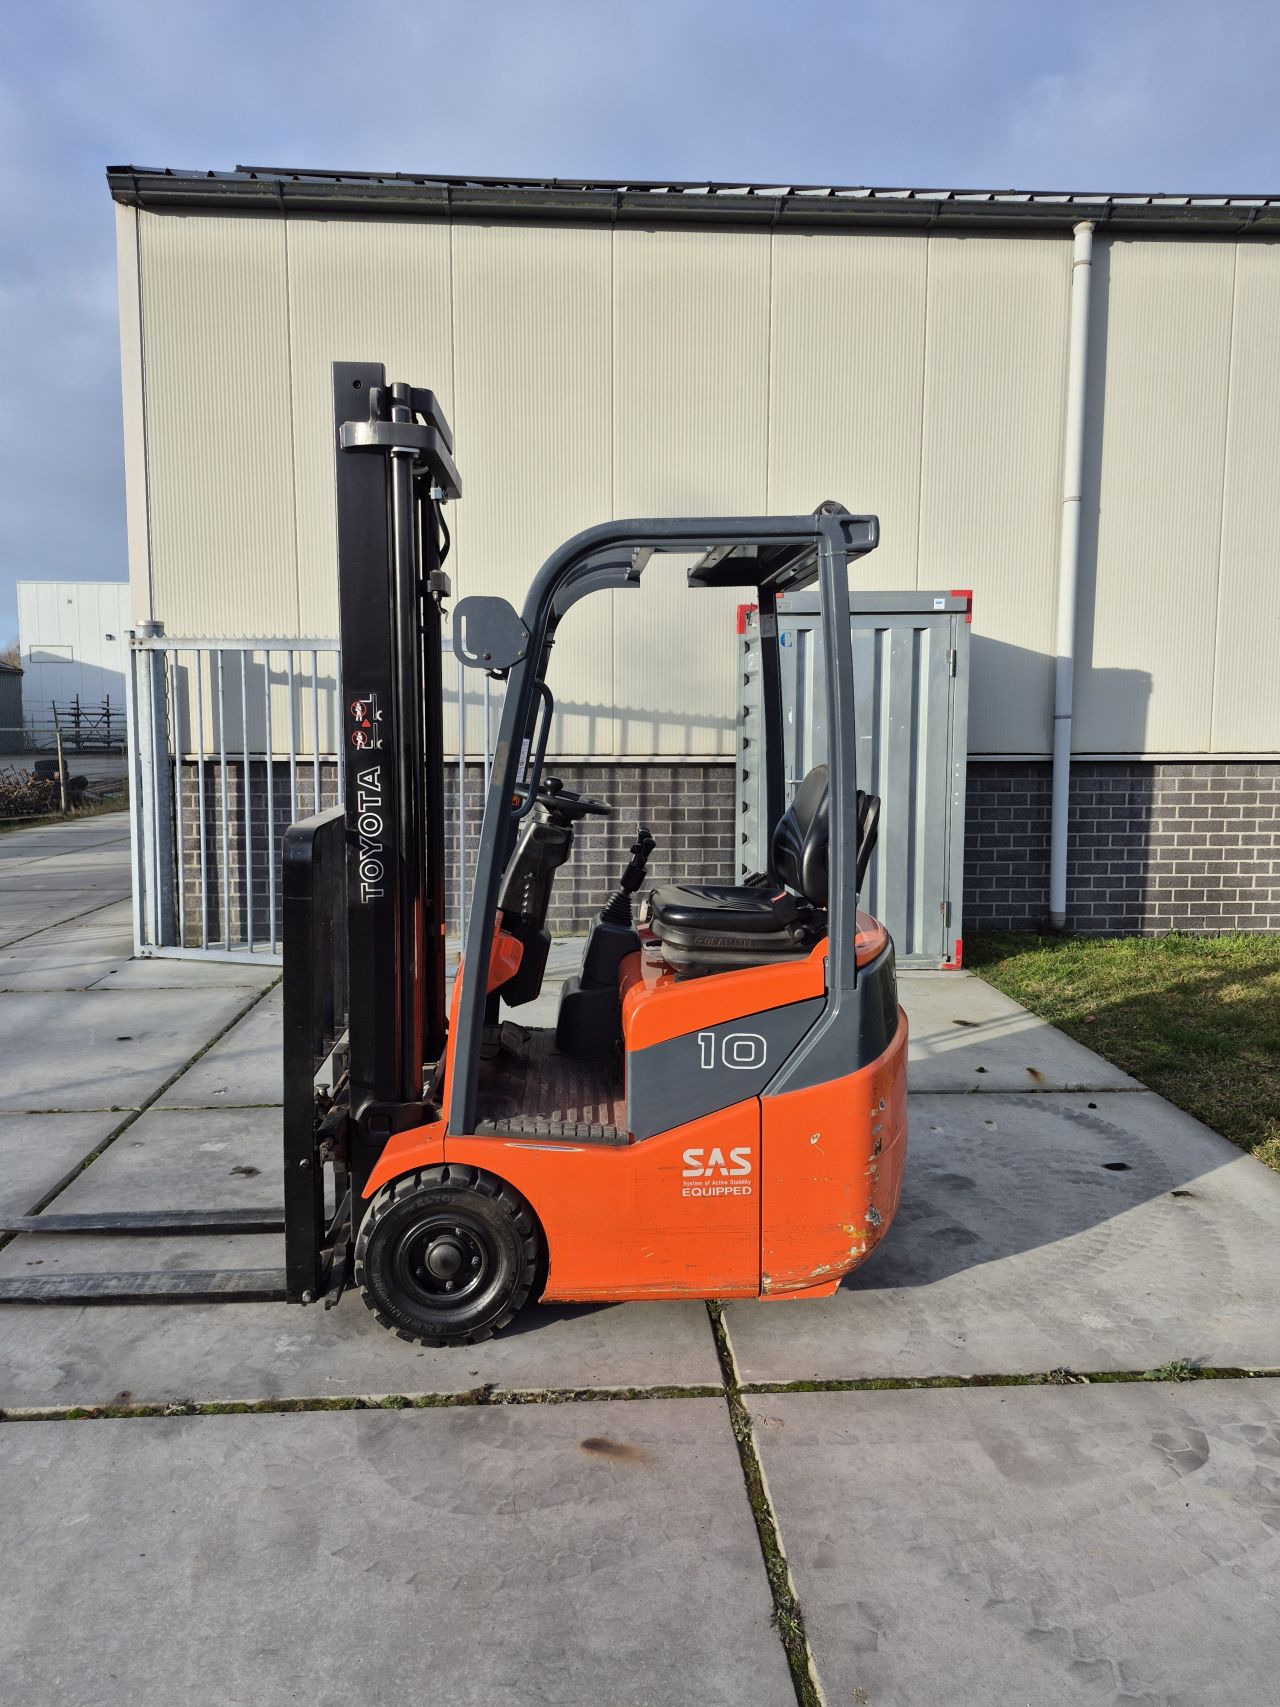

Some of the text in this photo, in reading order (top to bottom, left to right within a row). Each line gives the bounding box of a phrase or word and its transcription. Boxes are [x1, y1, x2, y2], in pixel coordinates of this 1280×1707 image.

[357, 765, 384, 904] TOYOTA
[698, 1033, 767, 1069] 10
[682, 1147, 752, 1177] SAS
[682, 1186, 752, 1197] EQUIPPED
